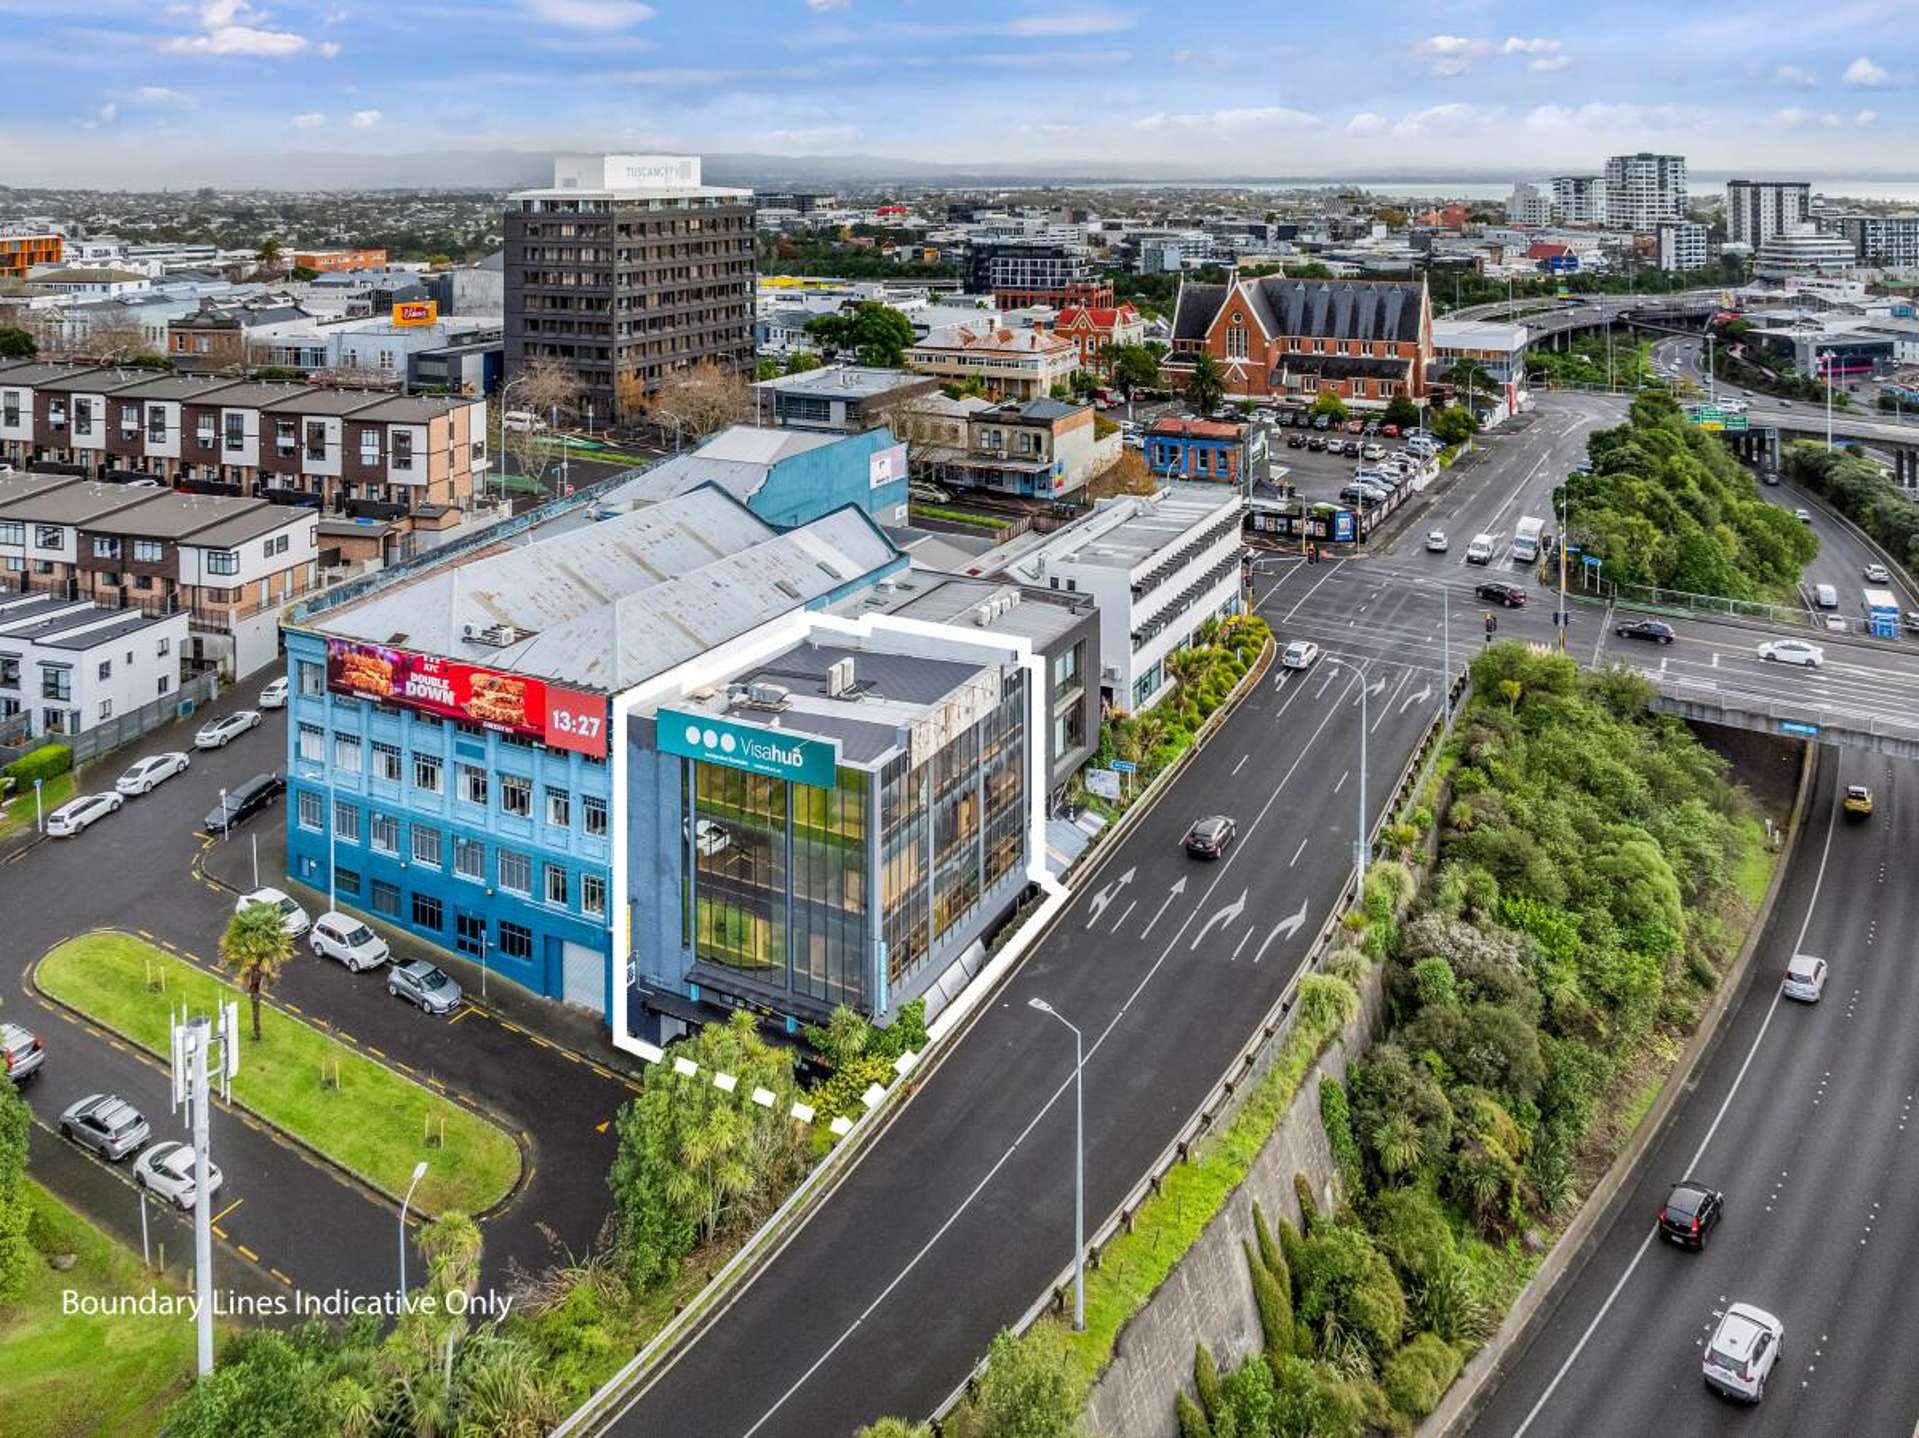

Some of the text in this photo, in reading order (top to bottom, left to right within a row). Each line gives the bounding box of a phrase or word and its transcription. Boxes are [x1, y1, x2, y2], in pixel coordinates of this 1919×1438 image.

[405, 681, 455, 706] DOWN
[410, 672, 449, 690] DOUBLE
[552, 709, 600, 738] 13:27
[740, 736, 804, 767] Visahub
